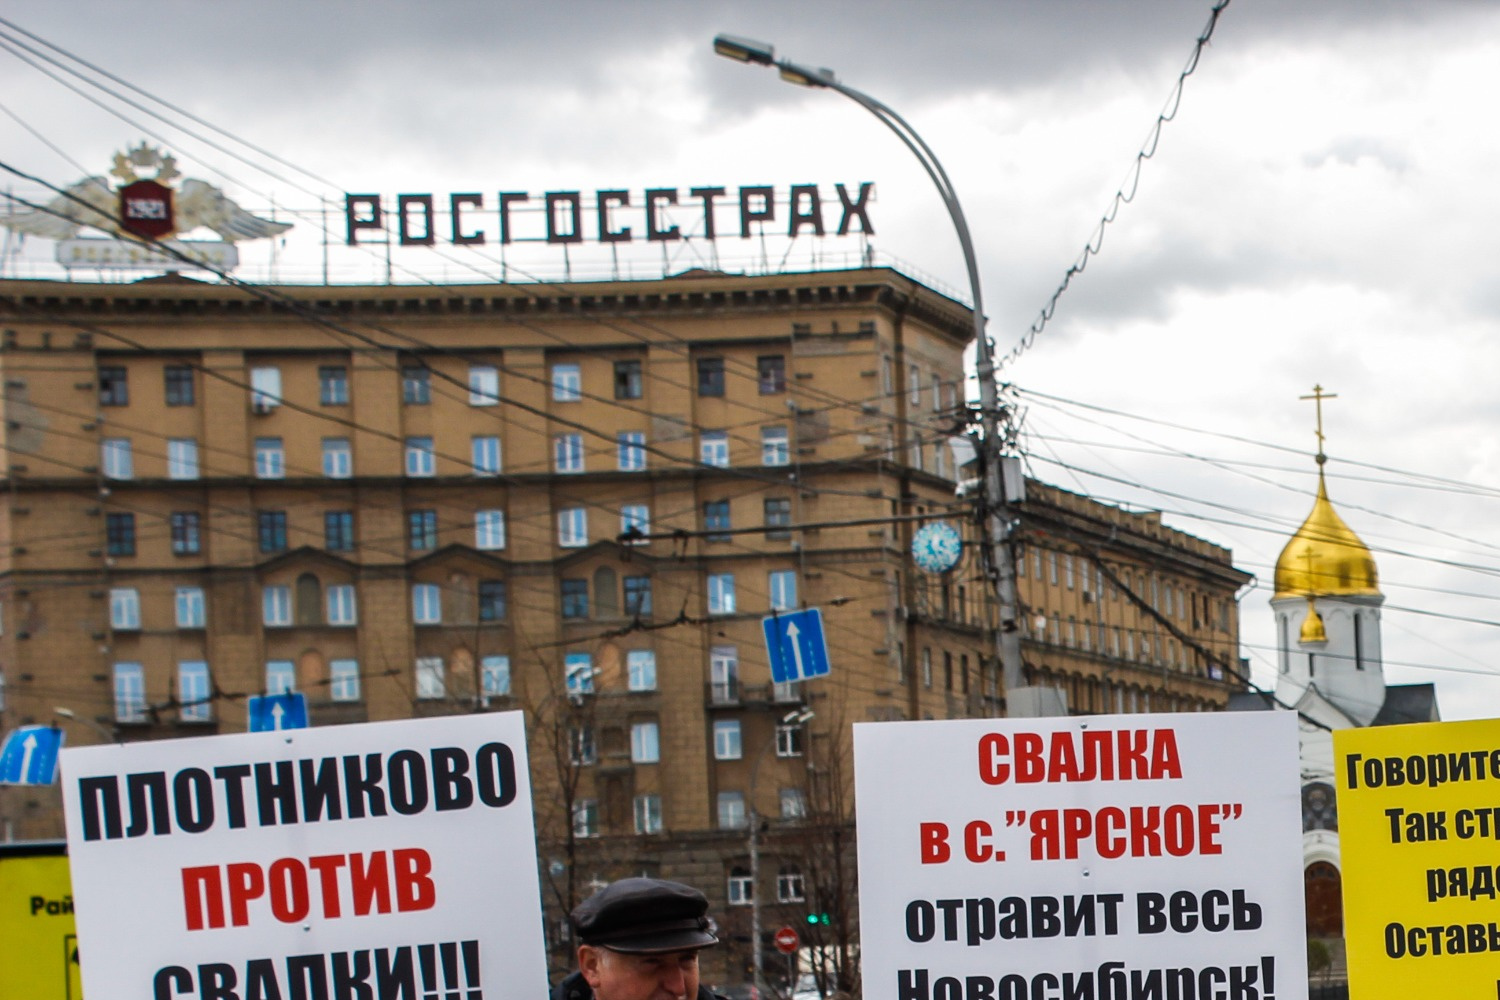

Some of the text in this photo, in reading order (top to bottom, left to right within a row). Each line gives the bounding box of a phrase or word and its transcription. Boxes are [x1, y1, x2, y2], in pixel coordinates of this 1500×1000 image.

[346, 182, 876, 246] РОСГОССТРАХ
[979, 729, 1182, 785] СВАЛКА
[79, 739, 516, 841] ПЛОТНИКОВО
[921, 804, 1242, 864] в с.”ЯРСКОЕ”
[1385, 808, 1447, 843] Так
[182, 848, 435, 930] ПРОТИВ
[906, 890, 1262, 946] отравит весь
